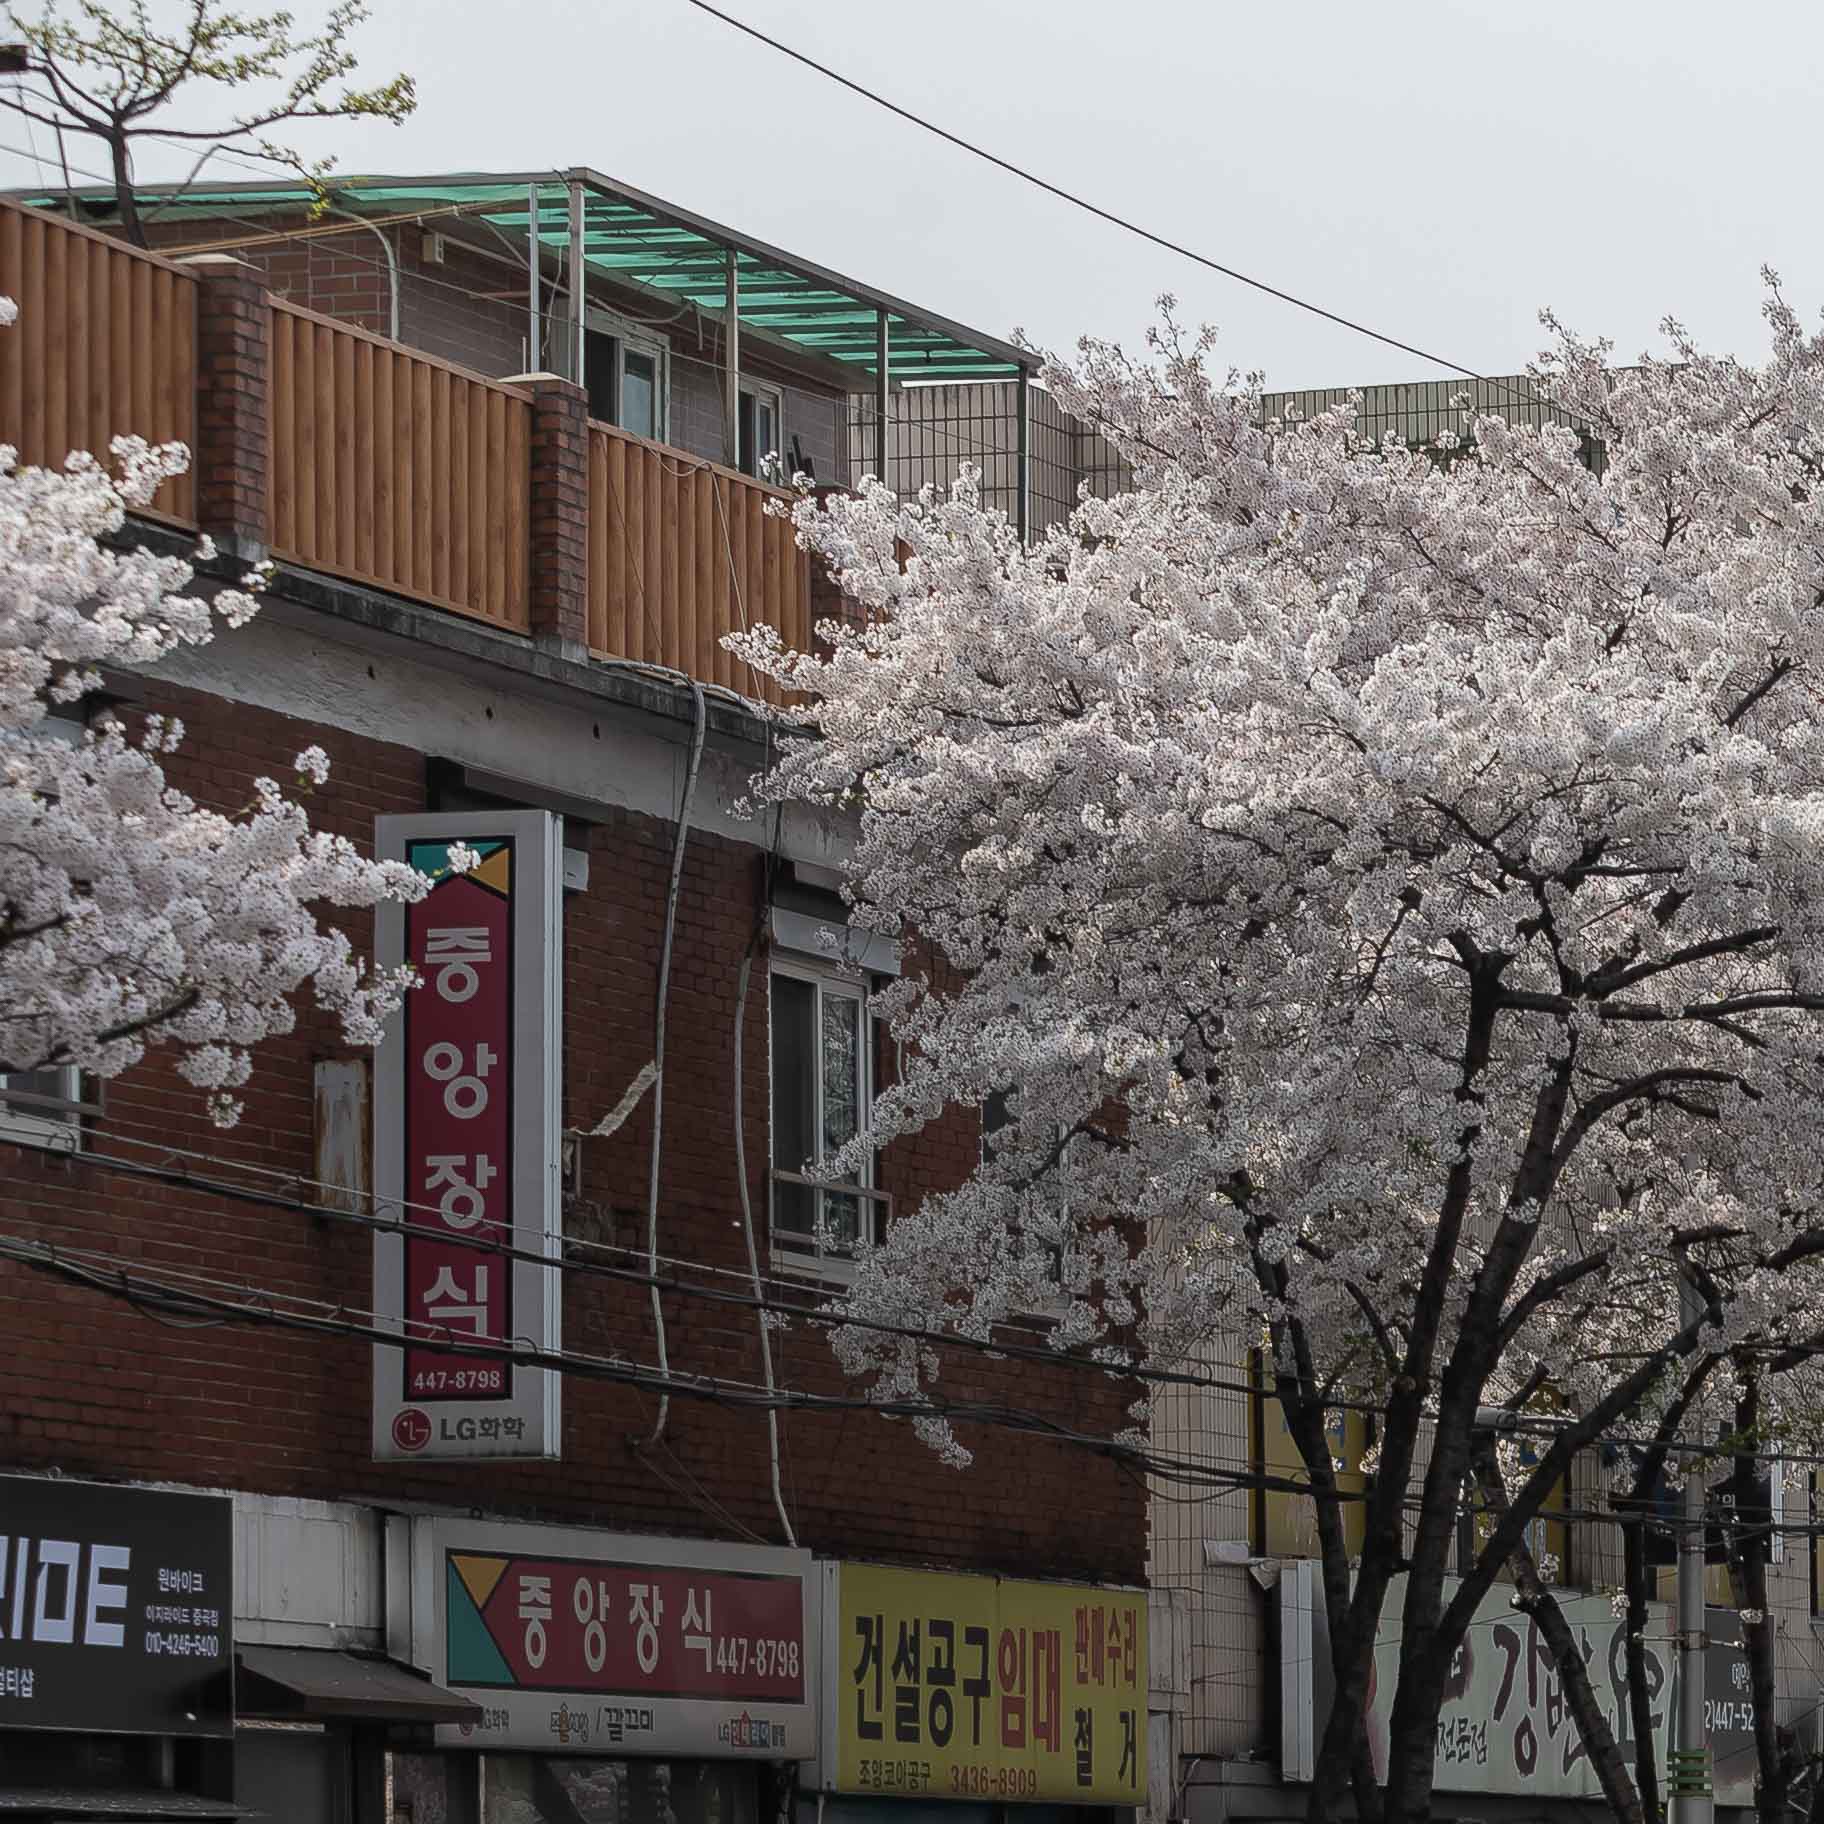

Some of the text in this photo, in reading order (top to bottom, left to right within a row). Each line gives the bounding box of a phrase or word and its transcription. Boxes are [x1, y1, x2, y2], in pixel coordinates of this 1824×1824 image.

[424, 927, 498, 1338] 중앙장식
[413, 1370, 501, 1390] 447-8798
[440, 1416, 525, 1441] LG화학
[0, 1535, 131, 1648] IDE
[158, 1567, 204, 1593] 원바이크
[518, 1575, 713, 1674] 중앙장식
[716, 1636, 800, 1679] 447-8798
[1730, 1661, 1753, 1693] 예
[853, 1613, 1061, 1753] 건설공구임대
[1436, 1716, 1488, 1765] 전문점
[951, 1764, 1037, 1795] 3436-8909
